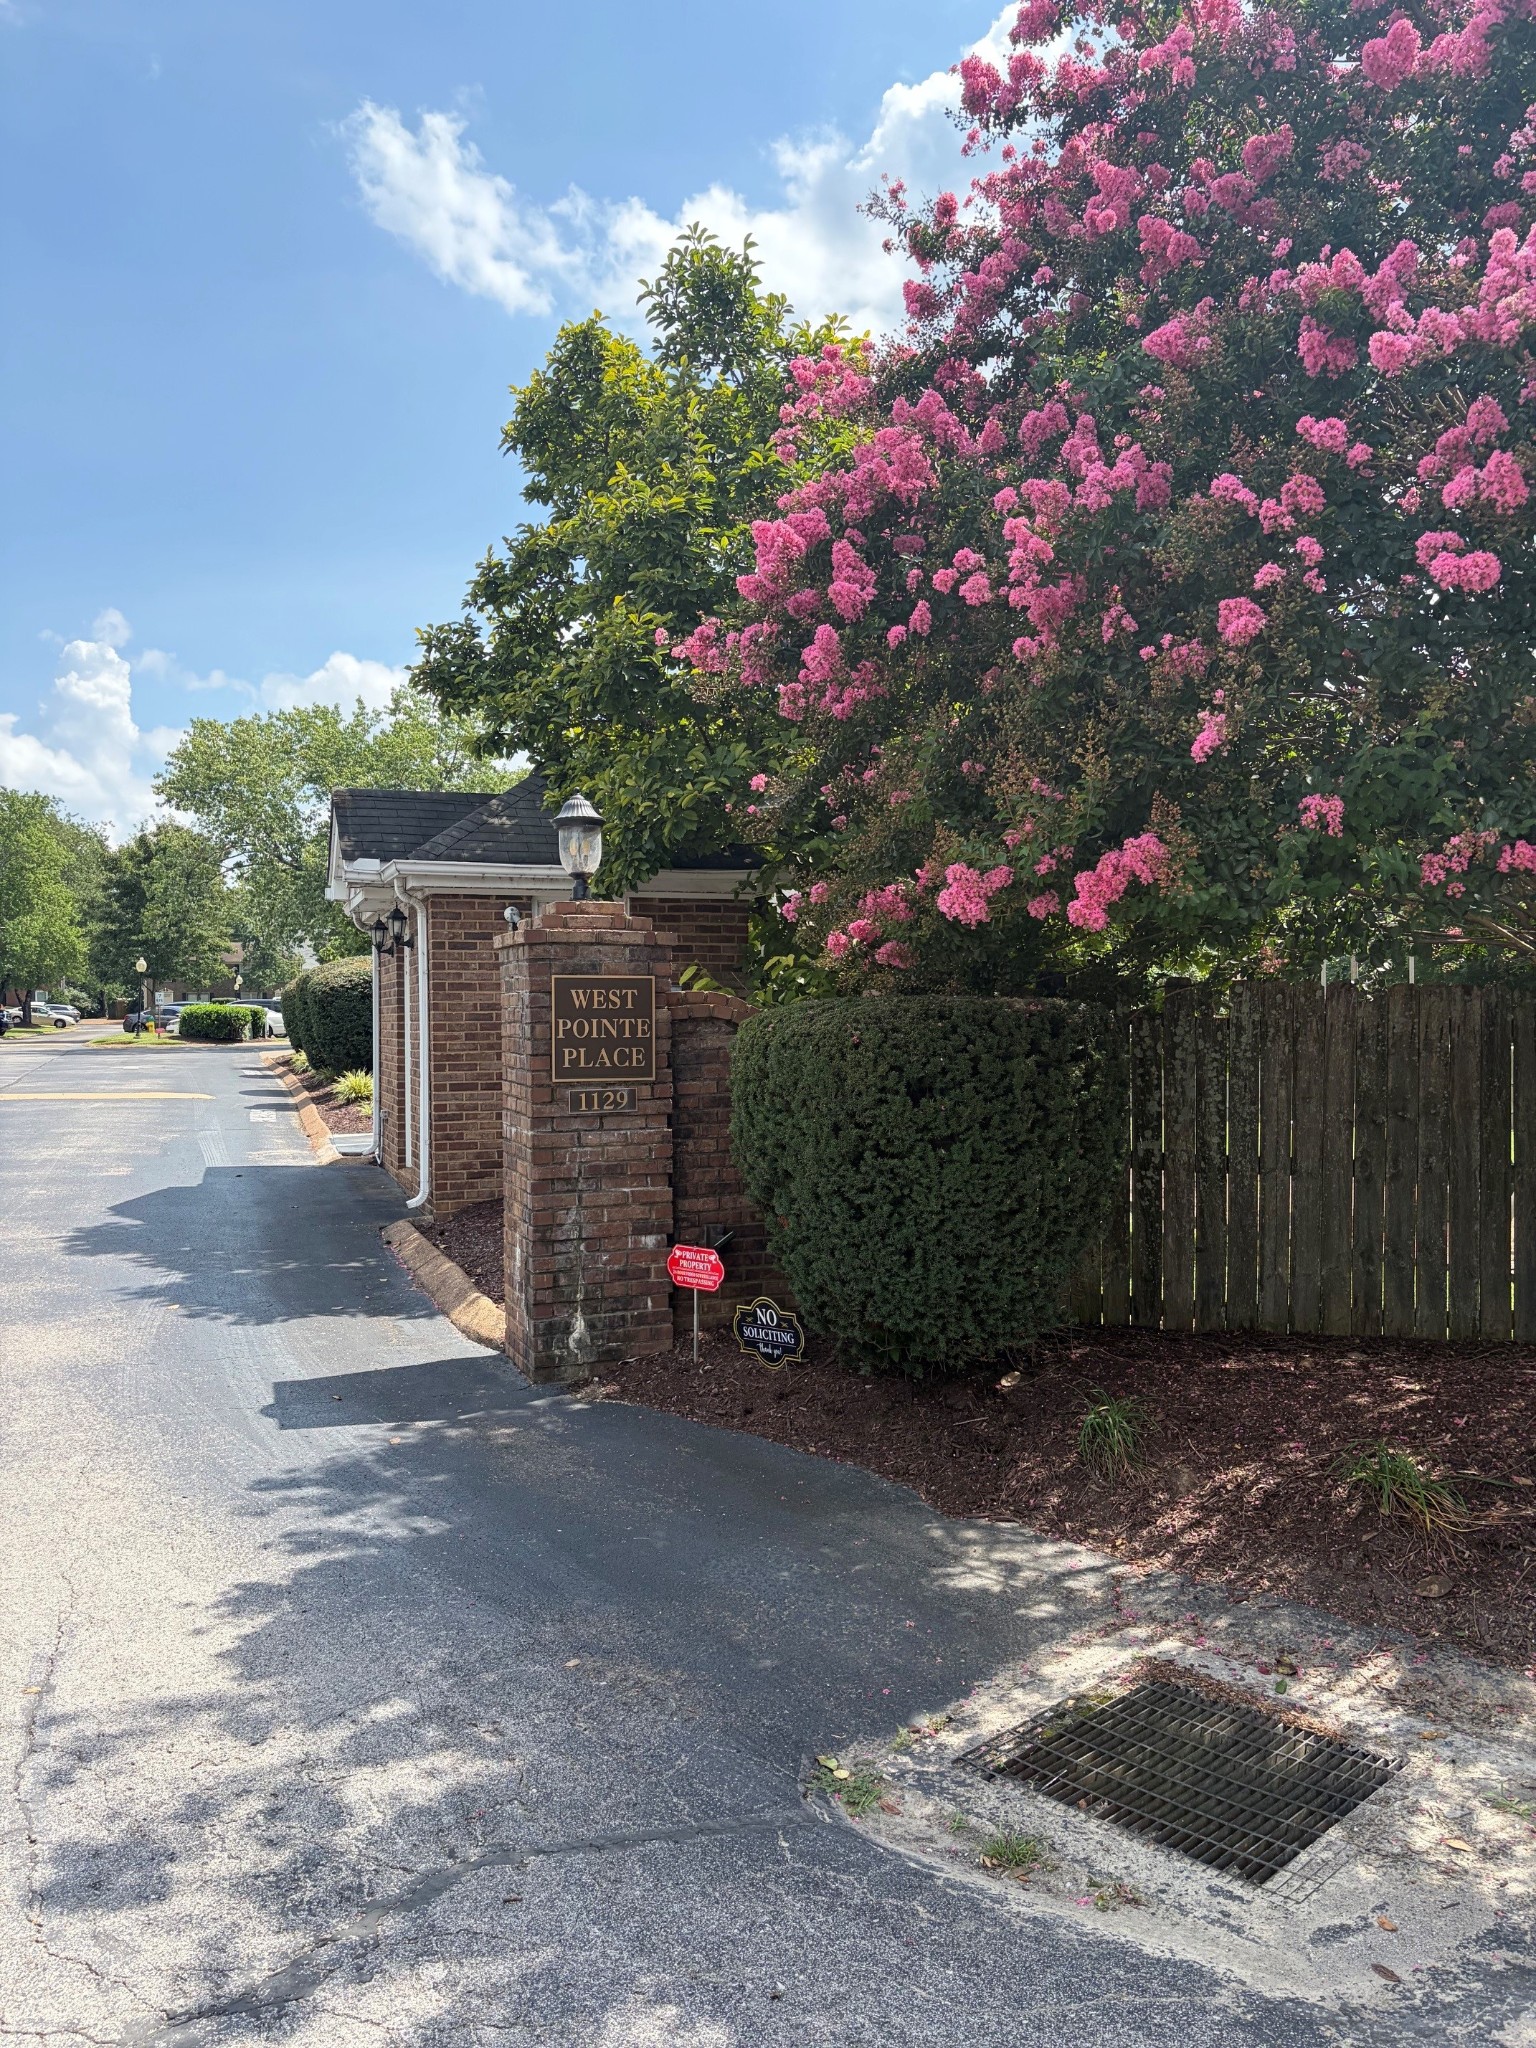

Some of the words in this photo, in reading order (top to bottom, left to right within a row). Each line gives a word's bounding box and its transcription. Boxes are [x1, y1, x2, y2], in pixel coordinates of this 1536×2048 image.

[570, 989, 638, 1009] WEST
[556, 1018, 651, 1039] POINTE
[562, 1047, 646, 1068] PLACE
[579, 1091, 628, 1111] 1129
[679, 1260, 711, 1271] PROPERTY
[682, 1251, 709, 1262] PRIVATE
[756, 1307, 777, 1326] NO
[743, 1326, 795, 1344] SOLICITING
